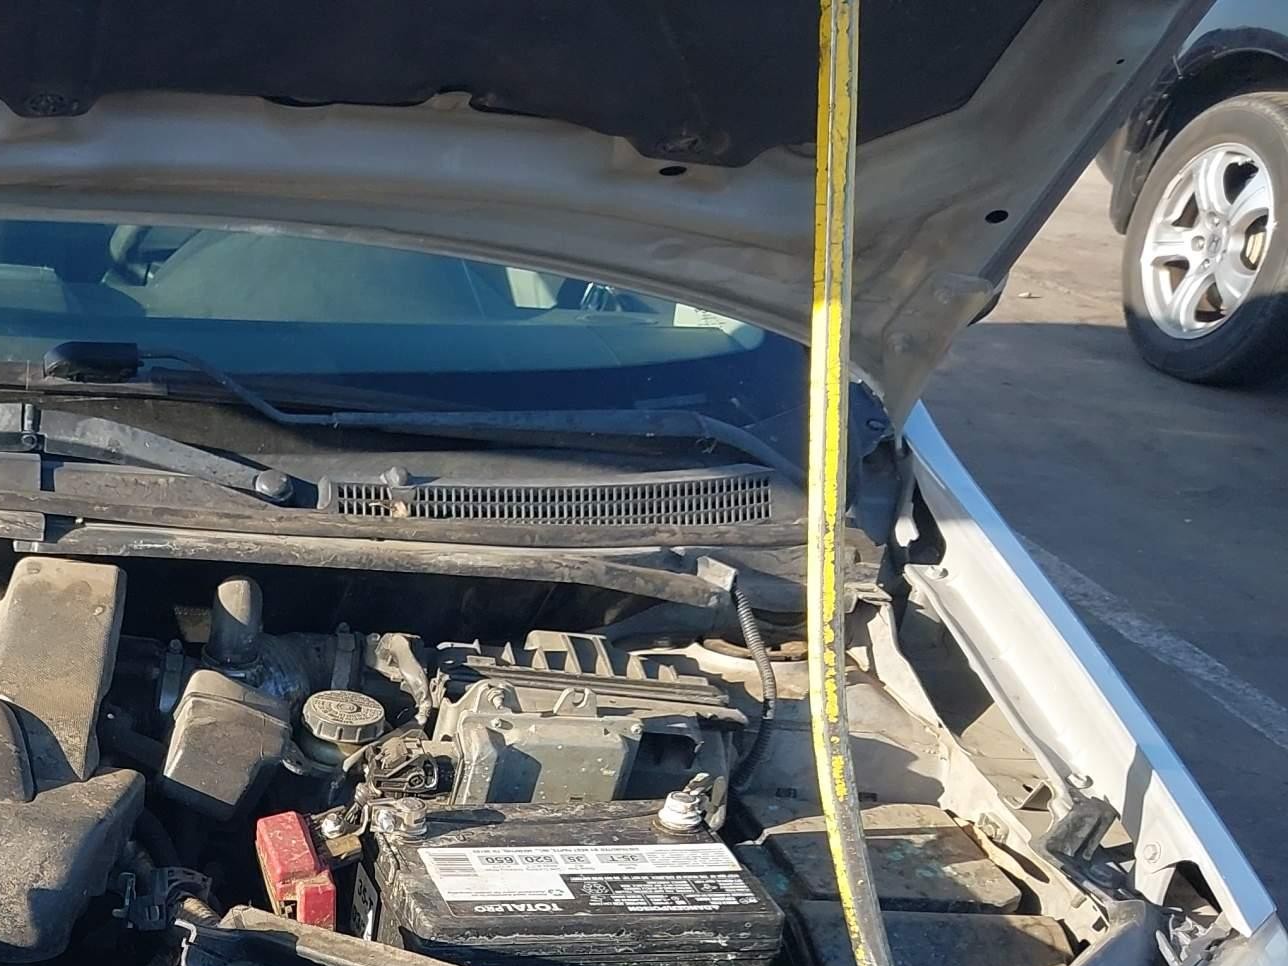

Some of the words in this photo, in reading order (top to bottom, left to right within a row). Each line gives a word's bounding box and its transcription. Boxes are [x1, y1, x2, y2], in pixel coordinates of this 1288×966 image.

[485, 855, 514, 864] 650
[525, 855, 553, 864] 520
[569, 855, 585, 863] 35
[474, 903, 563, 913] TOTALPRO
